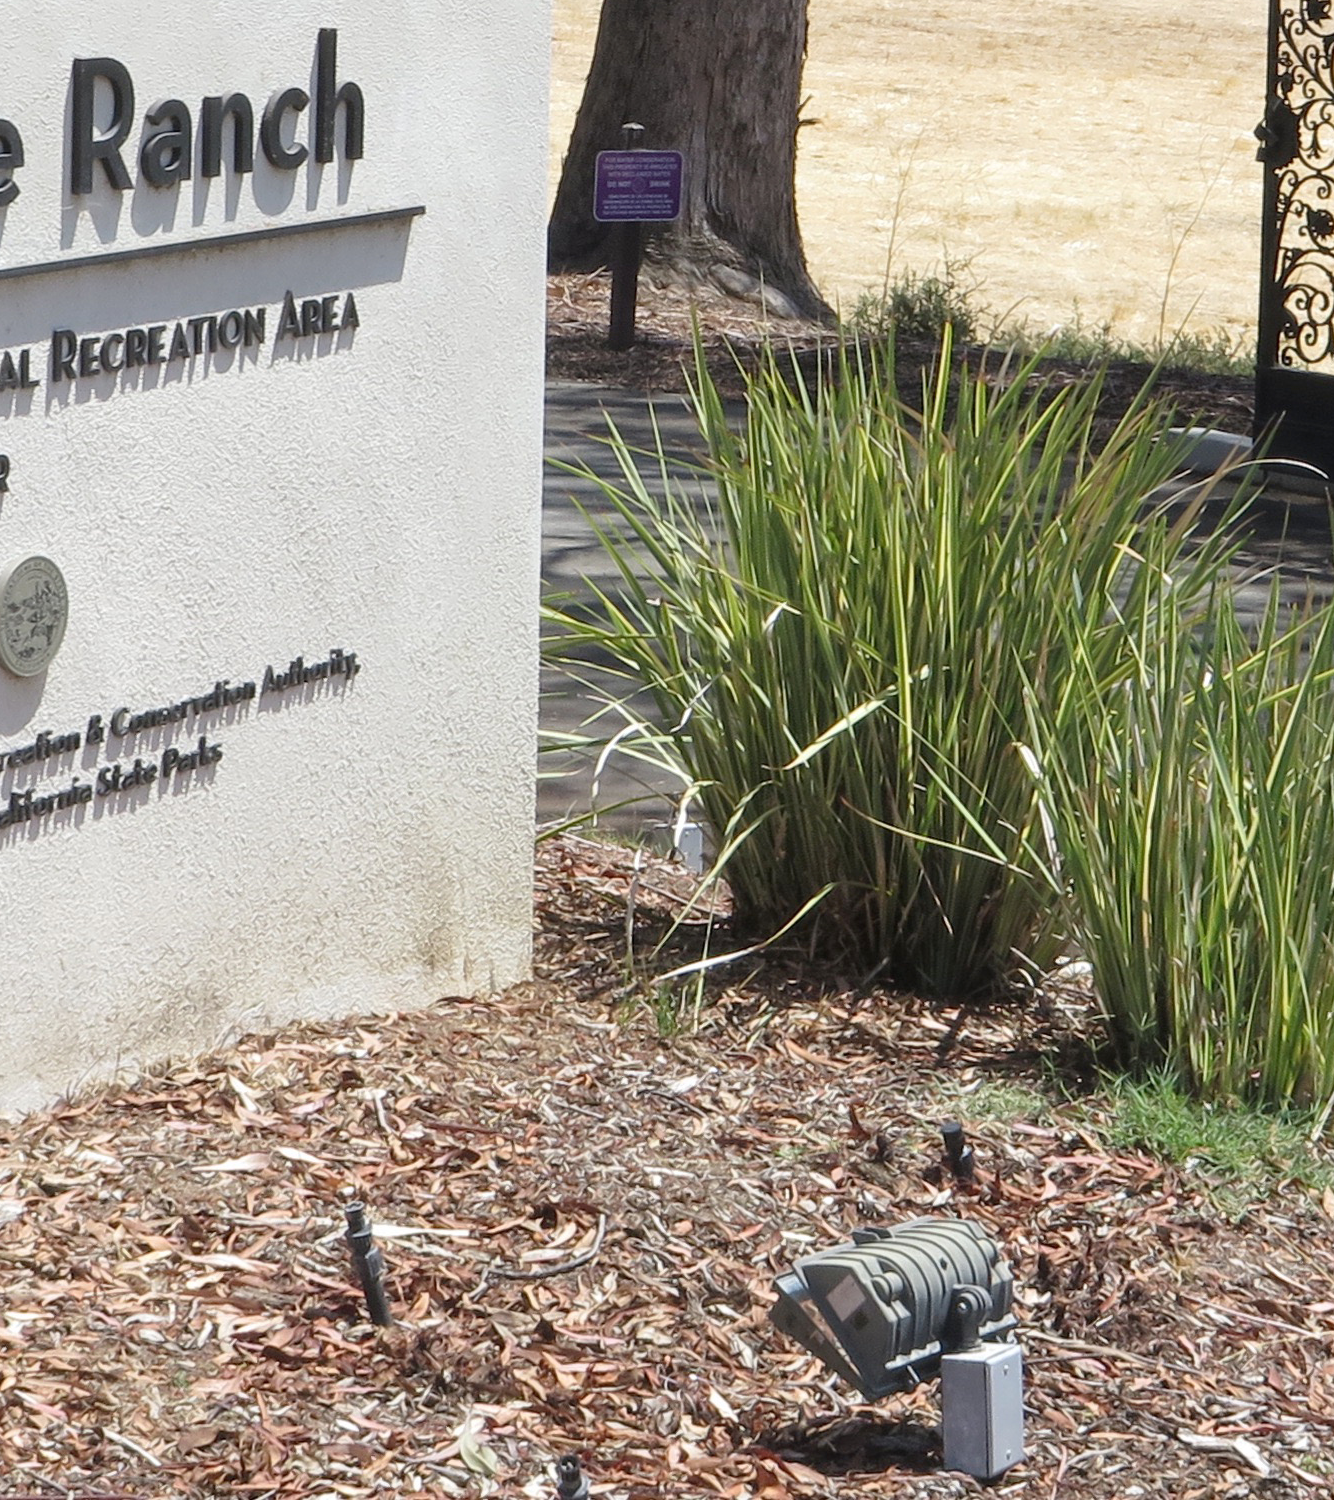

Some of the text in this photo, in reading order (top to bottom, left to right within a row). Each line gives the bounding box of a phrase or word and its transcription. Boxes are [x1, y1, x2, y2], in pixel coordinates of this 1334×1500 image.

[69, 27, 365, 195] Ranch
[51, 307, 266, 383] RECREATION
[278, 289, 360, 340] AREA
[85, 715, 104, 746] &
[110, 679, 256, 738] Conservation
[97, 758, 158, 797] State
[162, 735, 224, 779] Parks
